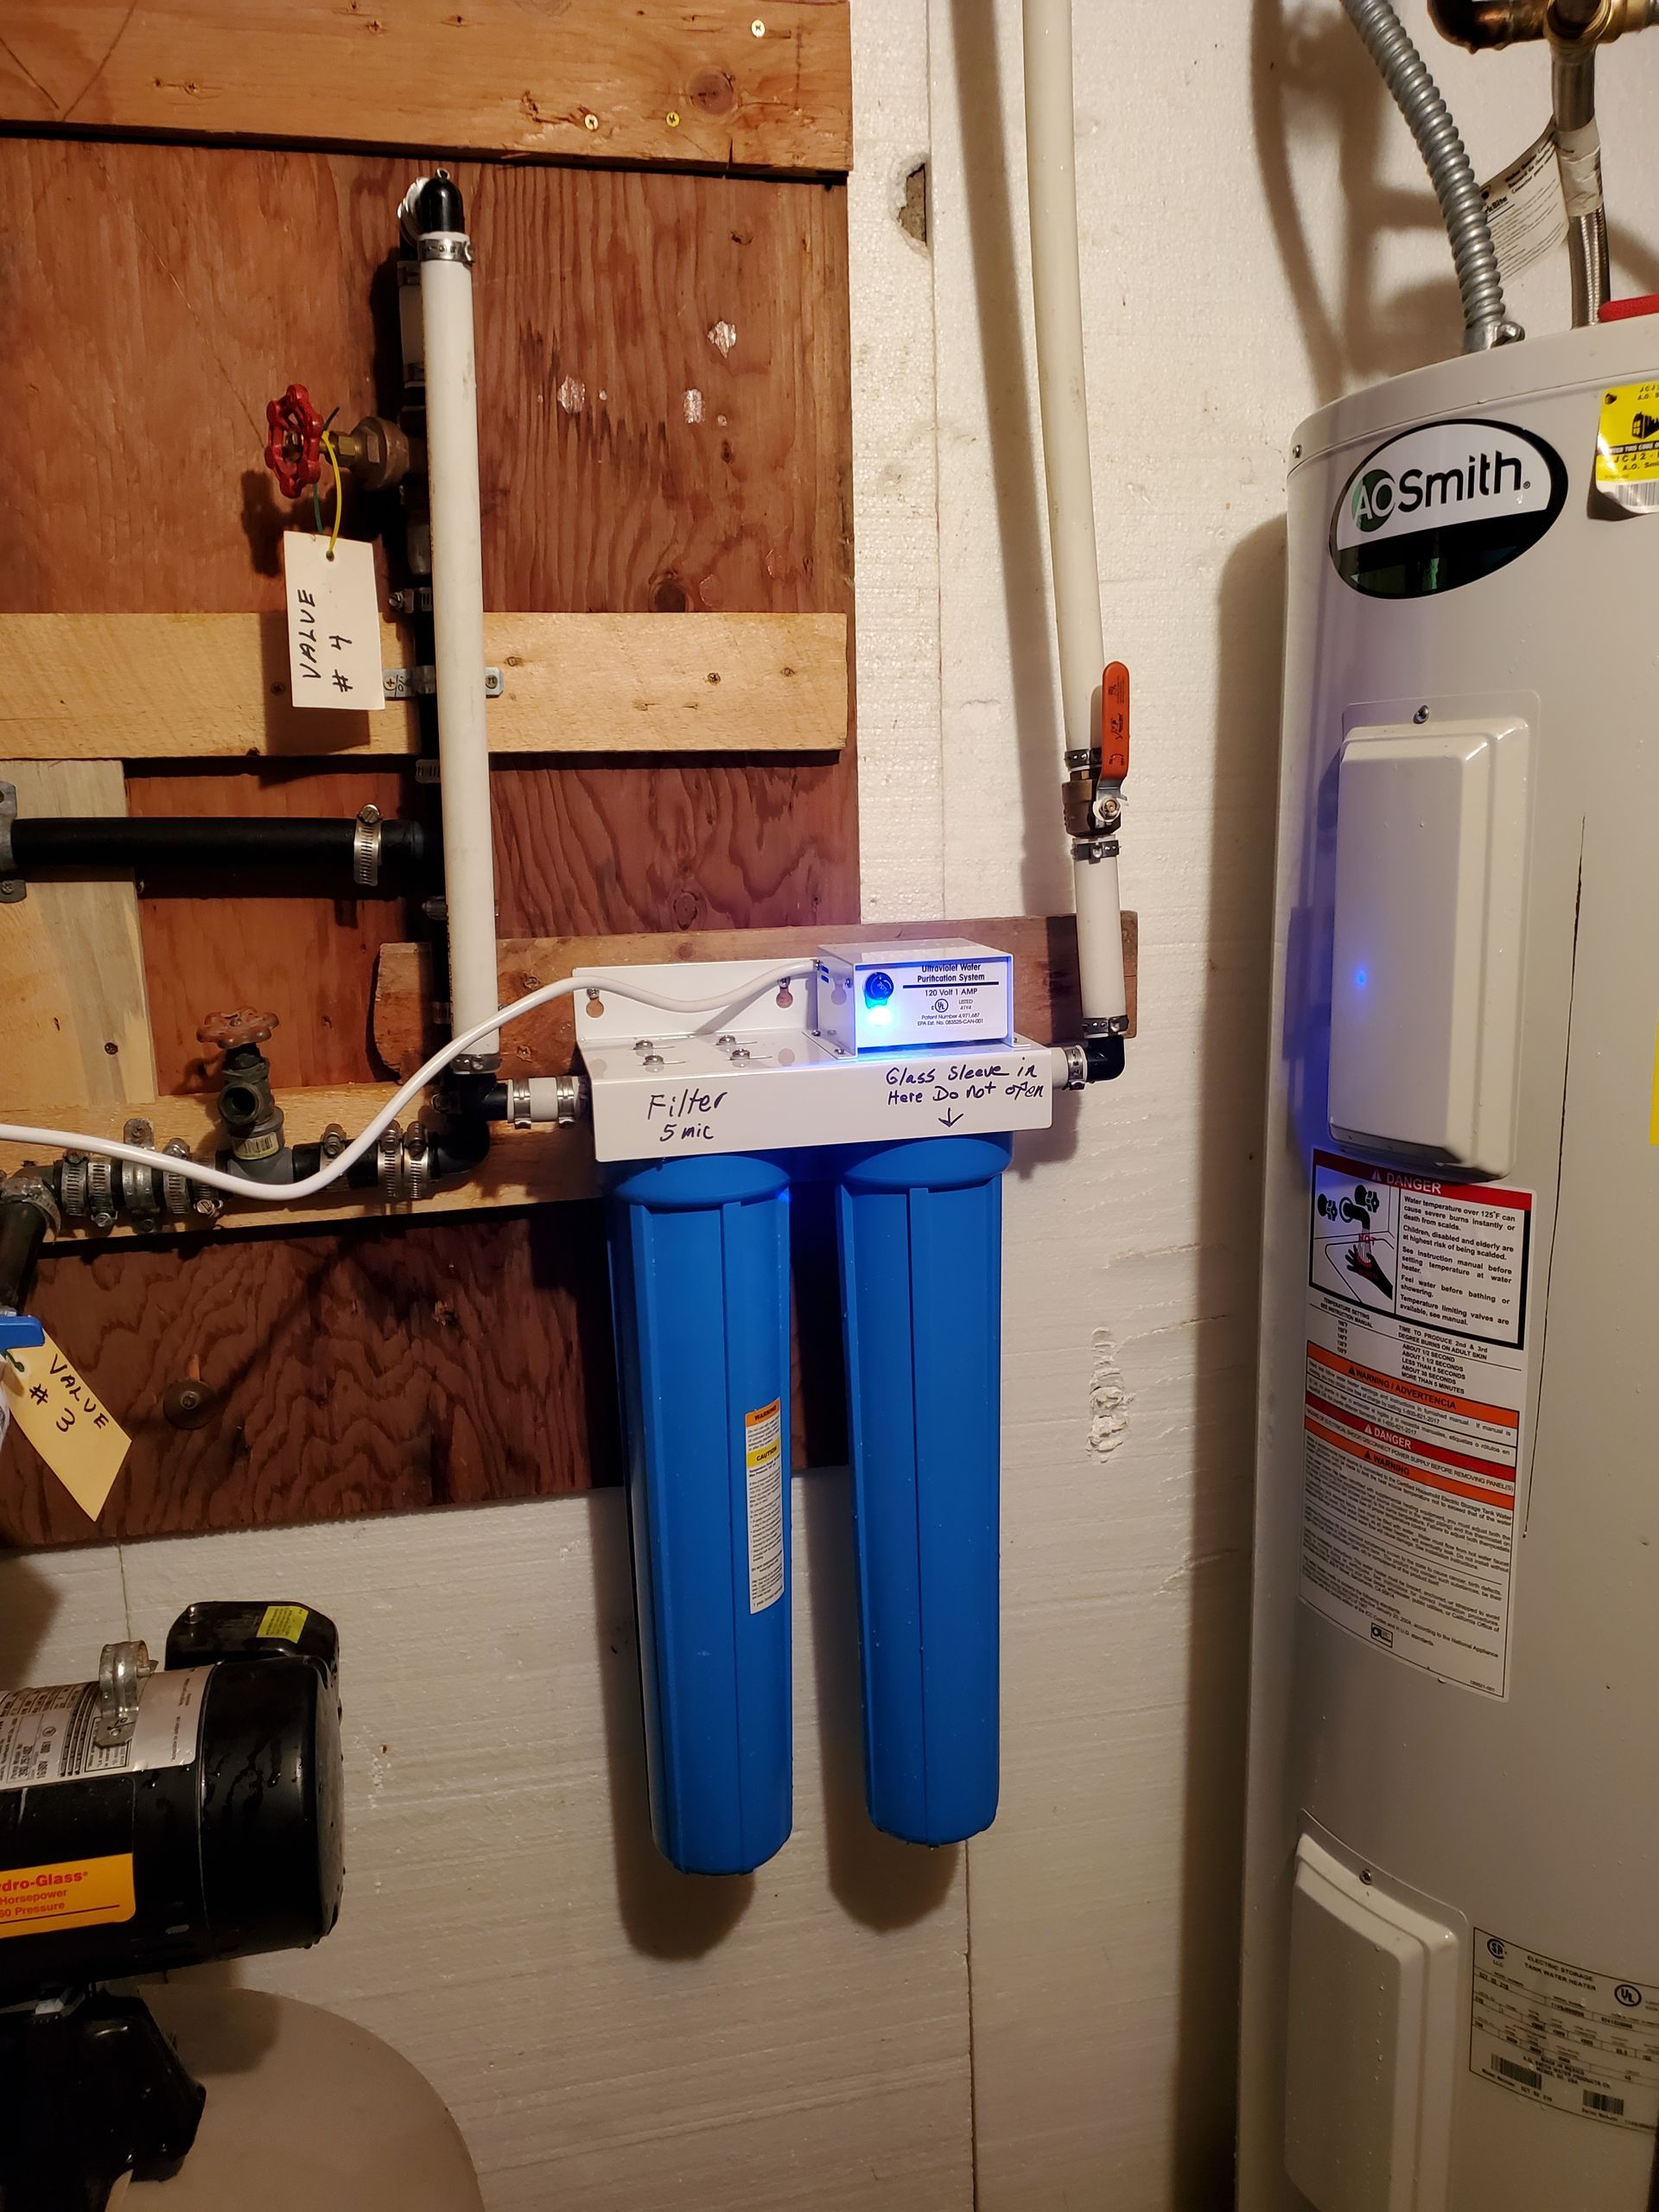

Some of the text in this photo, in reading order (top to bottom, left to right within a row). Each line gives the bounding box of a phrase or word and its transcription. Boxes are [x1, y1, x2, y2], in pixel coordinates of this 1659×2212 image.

[298, 588, 322, 680] VALVE
[329, 635, 353, 651] 4
[917, 973, 985, 983] Purification System
[921, 963, 982, 973] Ultraviolet Water
[886, 1057, 1038, 1086] Glass Sleeve in
[648, 1088, 728, 1120] Filter
[887, 1090, 923, 1105] Here
[932, 1086, 960, 1102] Do
[659, 1123, 715, 1142] 5 mic
[1386, 1172, 1441, 1195] DANGER
[1404, 1195, 1421, 1205] Water
[1423, 1199, 1462, 1213] temperature
[1403, 1213, 1461, 1231] death from scalds.
[1404, 1205, 1421, 1214] cause
[1425, 1211, 1446, 1219] severe
[1449, 1214, 1469, 1224] burns
[1472, 1218, 1503, 1230] instantly
[1403, 1224, 1430, 1237] Children,
[1432, 1231, 1459, 1243] disabled
[1461, 1237, 1475, 1246] and
[1476, 1241, 1501, 1251] elderly
[1410, 1236, 1433, 1247] highest
[1434, 1240, 1446, 1249] risk
[1456, 1245, 1476, 1255] being
[1477, 1249, 1507, 1260] scalded.
[1402, 1246, 1513, 1275] See instruction manual before
[1402, 1263, 1421, 1274] heater.
[1402, 1255, 1423, 1267] setting
[1429, 1262, 1470, 1276] temperature
[1491, 1275, 1512, 1284] water
[1401, 1274, 1414, 1284] Feel
[1418, 1280, 1436, 1289] water
[1441, 1284, 1463, 1295] before
[1468, 1290, 1496, 1303] bathing
[1401, 1283, 1433, 1299] showering.
[1400, 1294, 1439, 1311] Temperature
[1441, 1305, 1467, 1318] limiting
[1471, 1312, 1494, 1322] valves
[1442, 1313, 1468, 1326] manual.
[1398, 1325, 1411, 1334] TIME
[1424, 1332, 1452, 1344] PRODUCE
[1455, 1340, 1467, 1349] 2nd
[1478, 1345, 1488, 1354] 3rd
[1398, 1332, 1420, 1344] DEGREE
[1421, 1338, 1440, 1349] BURNS
[1451, 1347, 1471, 1357] ADULT
[1472, 1351, 1488, 1361] SKIN
[1402, 1343, 1421, 1354] ABOUT
[1431, 1351, 1455, 1363] SECOND
[1402, 1351, 1421, 1360] ABOUT
[1435, 1359, 1464, 1372] SECONDS
[1402, 1357, 1416, 1366] LESS
[1417, 1362, 1432, 1370] THAN
[1437, 1367, 1465, 1380] SECONDS
[1402, 1364, 1420, 1375] ABOUT
[1428, 1372, 1457, 1384] SECONDS
[49, 1353, 110, 1429] VALVE
[1357, 1367, 1389, 1389] WARNING
[1395, 1385, 1457, 1409] ADVERTENCIA
[1402, 1371, 1417, 1381] MORE
[1418, 1376, 1433, 1385] THAN
[1439, 1382, 1465, 1395] MINUTES
[1374, 1427, 1411, 1450] DANGER
[1482, 1425, 1504, 1435] manual
[756, 1446, 778, 1461] CAUTION
[1374, 1454, 1410, 1476] WARNING
[1391, 1447, 1410, 1461] POWER
[1410, 1455, 1430, 1468] SUPPLY
[1430, 1462, 1452, 1475] BEFORE
[1453, 1469, 1485, 1484] REMOVING
[0, 1890, 67, 1905] Horsepower
[15, 1902, 65, 1916] Pressure
[1524, 1962, 1597, 1992] TANK WATER HEATER
[1527, 1955, 1594, 1982] ELECTRIC STORAGE
